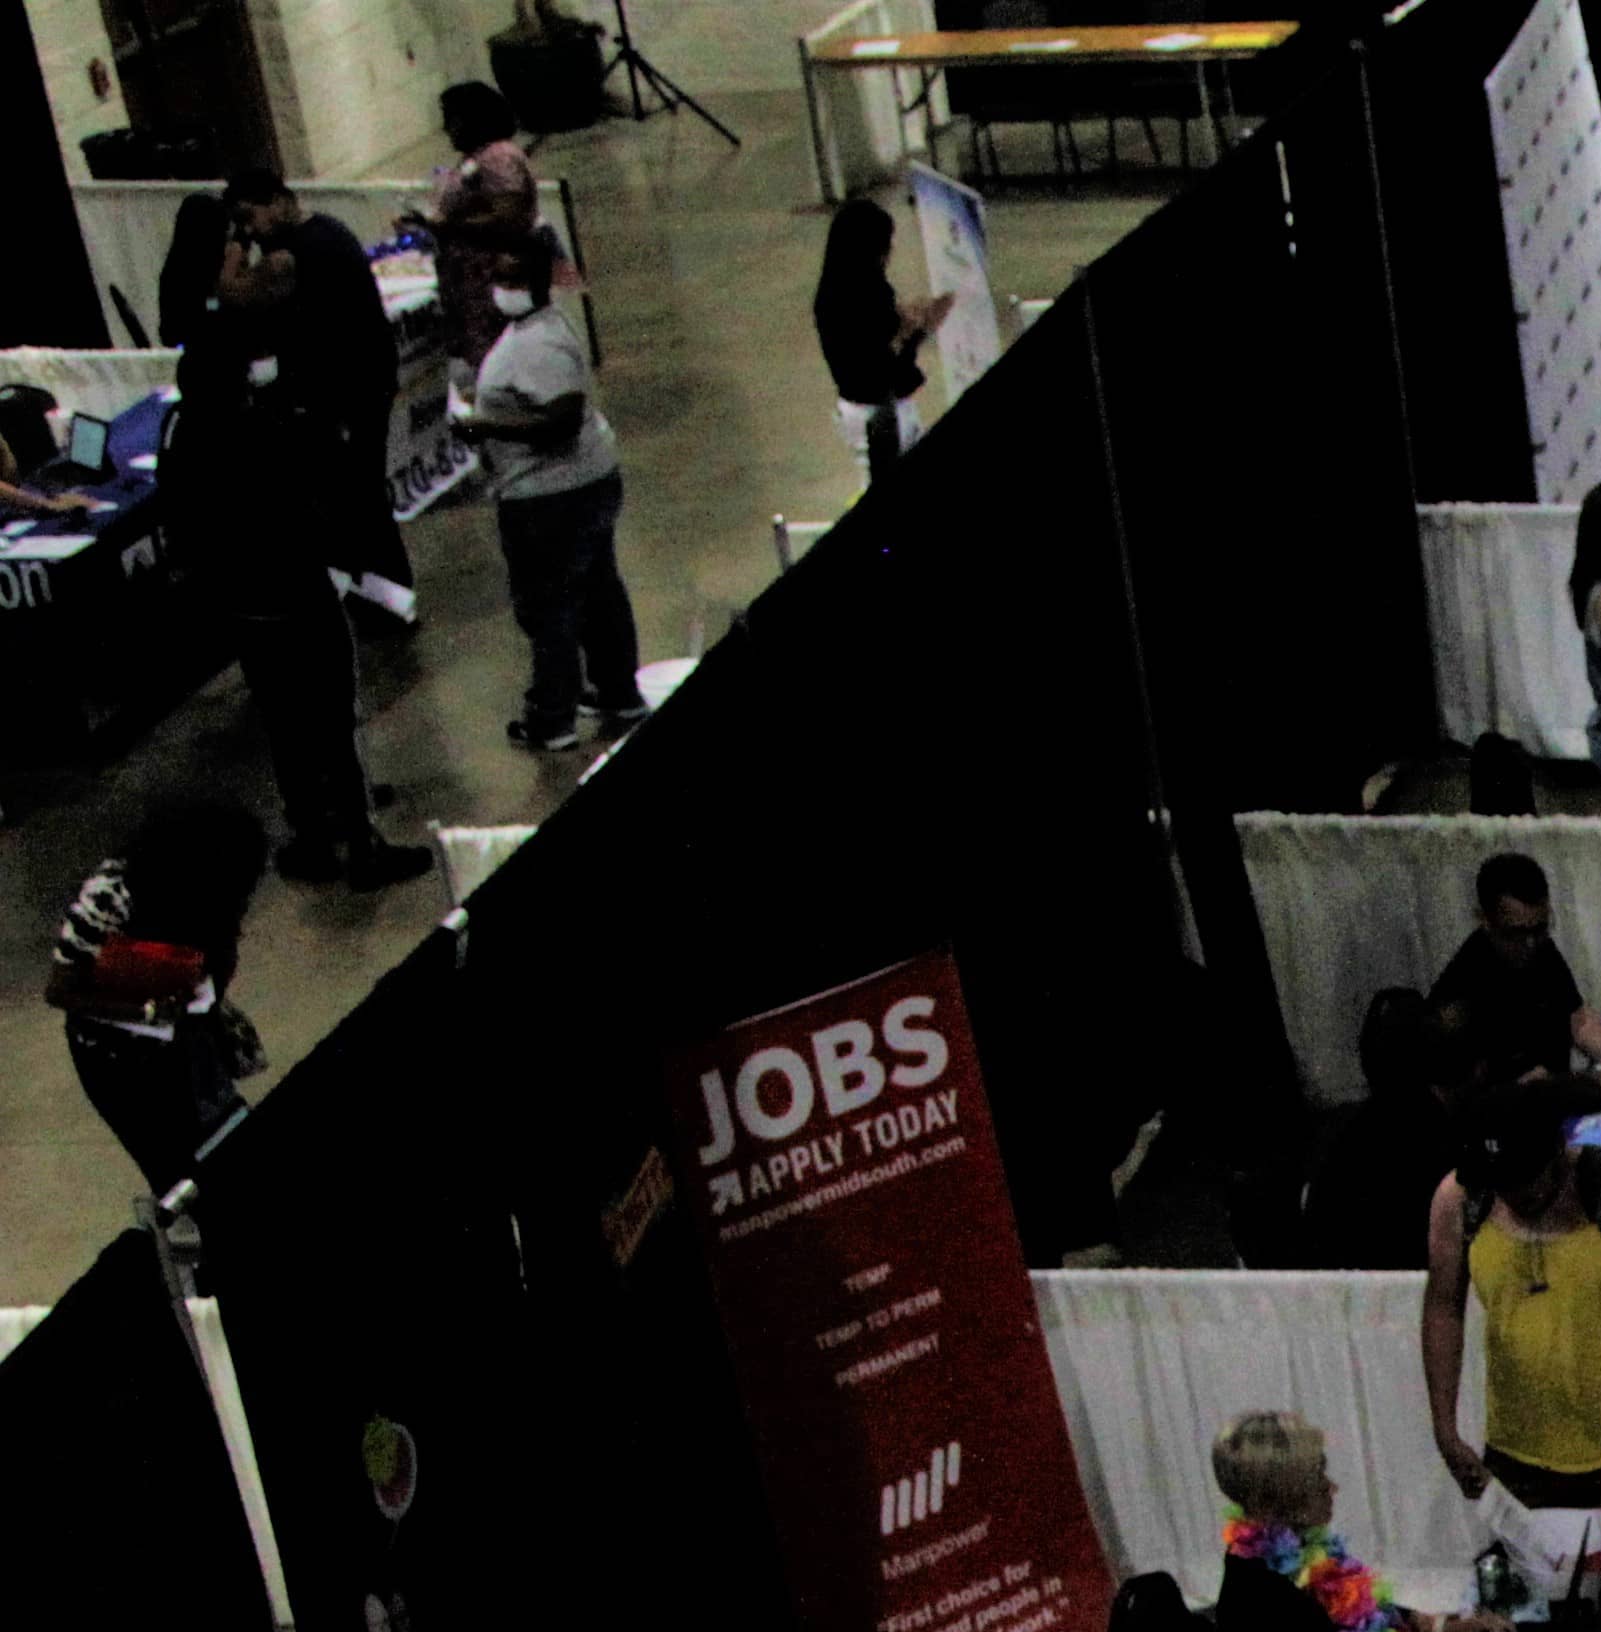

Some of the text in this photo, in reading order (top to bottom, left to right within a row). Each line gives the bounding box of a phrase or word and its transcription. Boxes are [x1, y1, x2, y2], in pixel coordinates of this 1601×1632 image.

[698, 995, 949, 1166] JOBS
[751, 1089, 959, 1199] APPLY TODAY
[718, 1135, 967, 1242] manpowermidsouth.com
[842, 1263, 892, 1292] TEMP
[815, 1287, 942, 1350] TEMP TO PERM
[835, 1332, 939, 1388] PERMANENT
[880, 1517, 991, 1581] Manpower
[935, 1577, 1001, 1616] choice
[1004, 1560, 1032, 1586] for
[975, 1586, 1040, 1632] people
[1043, 1576, 1063, 1597] in
